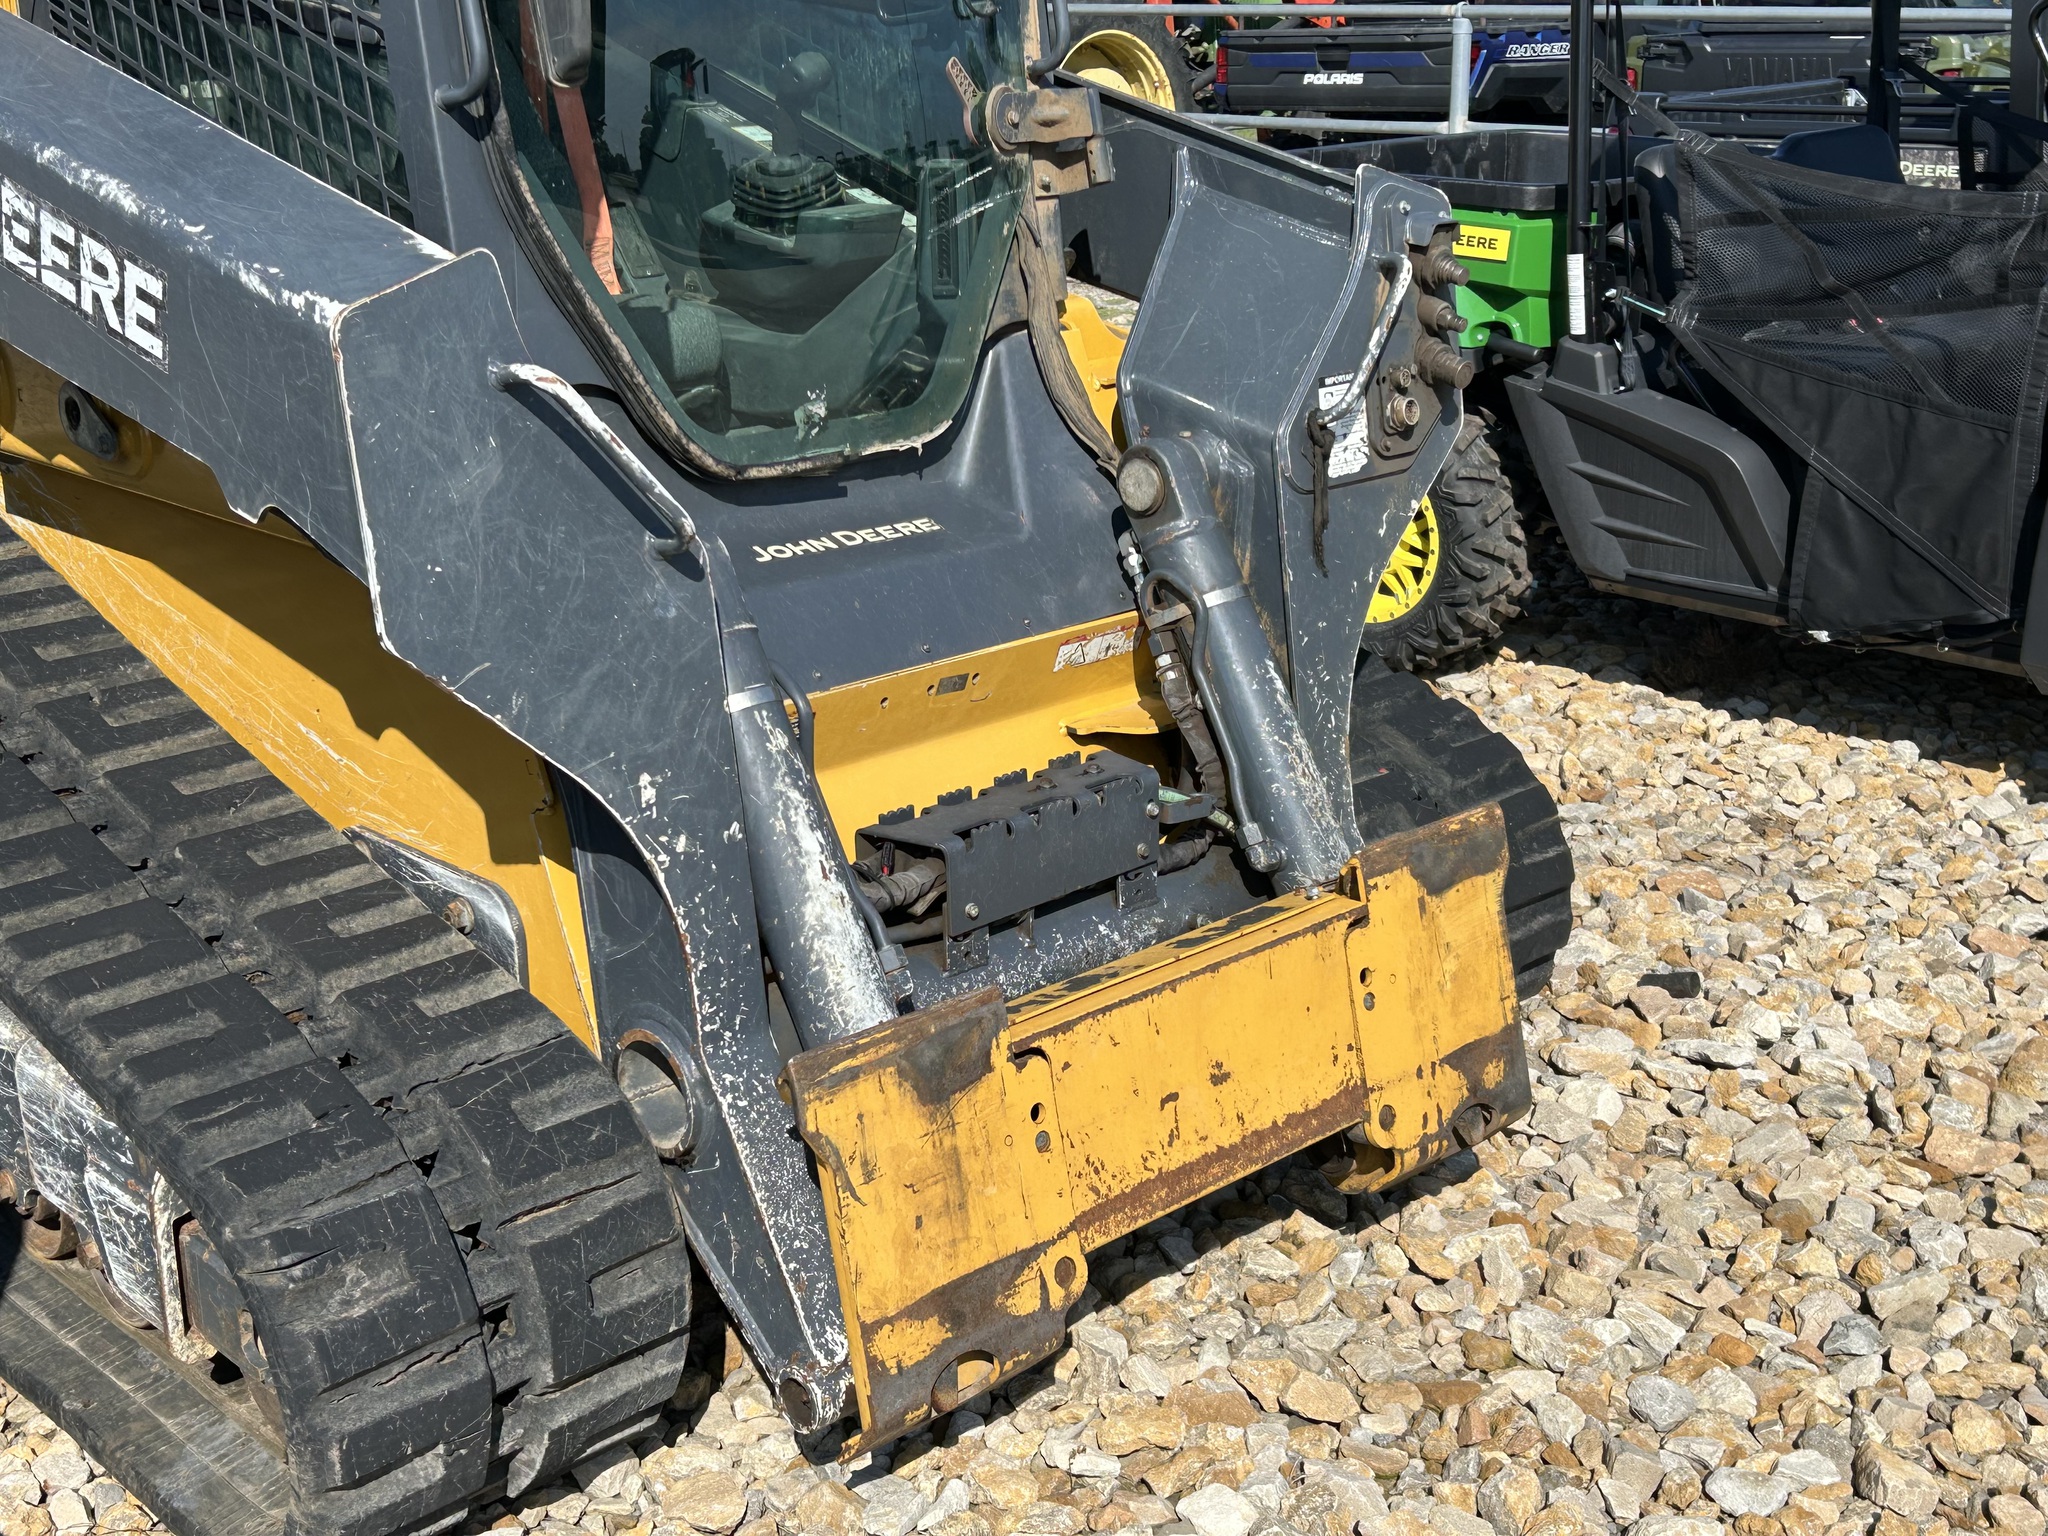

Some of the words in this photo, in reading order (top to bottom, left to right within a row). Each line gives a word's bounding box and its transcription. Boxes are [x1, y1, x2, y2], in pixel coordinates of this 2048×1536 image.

[1505, 42, 1570, 58] RANGER
[1303, 73, 1364, 85] POLARIS
[1900, 161, 1960, 178] DEERE
[1456, 234, 1498, 250] EERE
[0, 177, 164, 360] EERE
[1324, 372, 1355, 386] IMPORTAN
[752, 536, 839, 562] JOHN
[831, 517, 942, 546] DEERE
